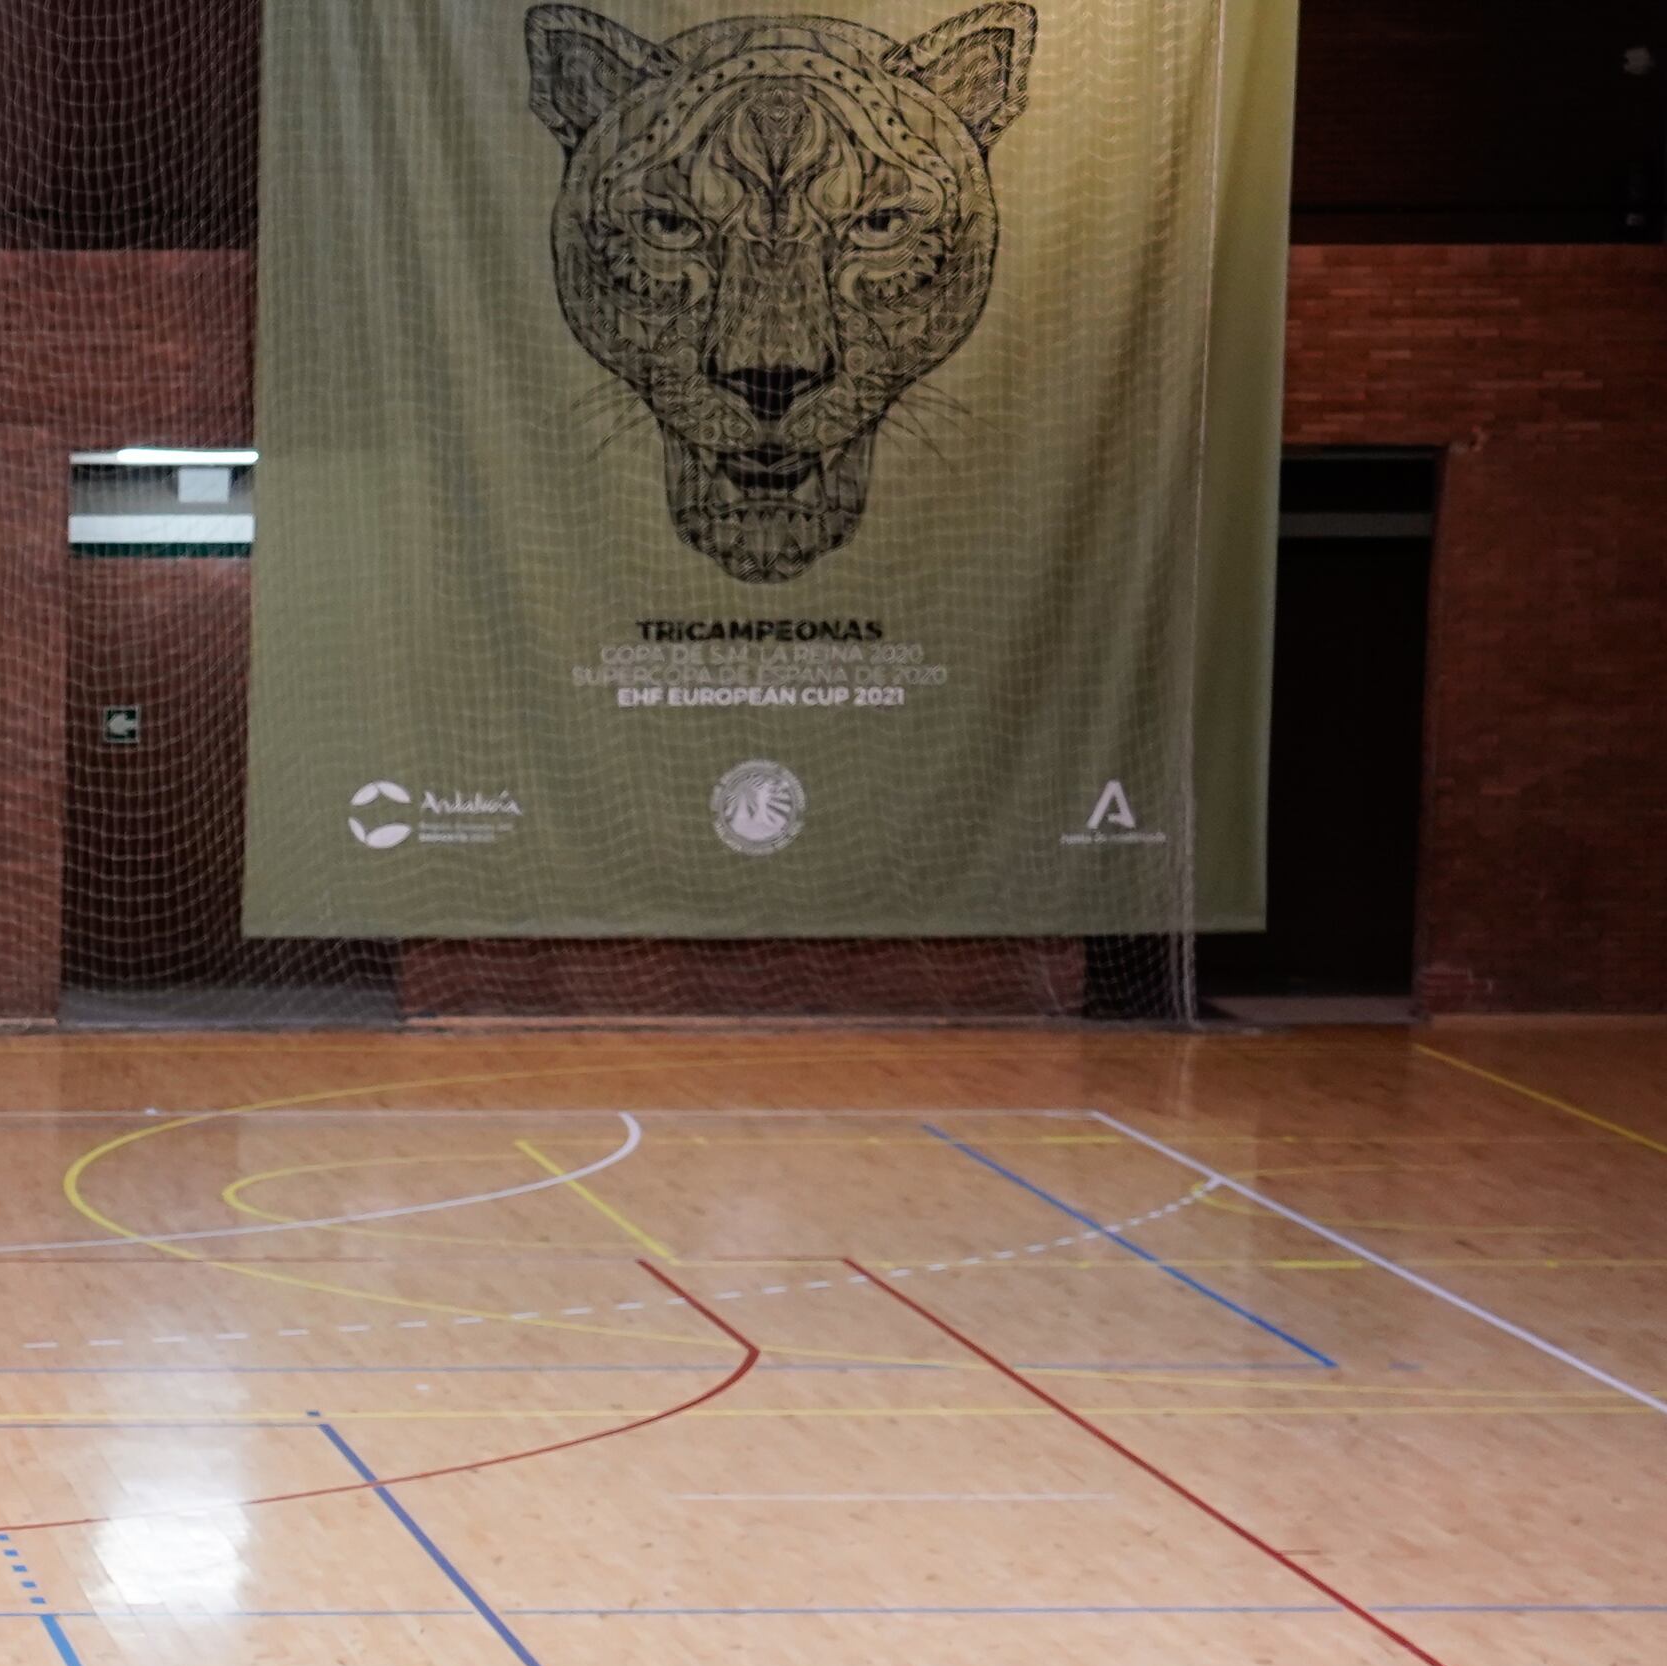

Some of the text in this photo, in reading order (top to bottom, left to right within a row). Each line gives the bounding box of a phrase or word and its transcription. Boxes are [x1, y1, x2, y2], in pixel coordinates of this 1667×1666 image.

[636, 619, 884, 642] TRICAMPEONAS
[601, 645, 665, 664] COPA
[671, 645, 704, 664] DE
[794, 644, 864, 664] REINA
[870, 643, 924, 663] 2020
[572, 666, 713, 687] SUPERCOPA
[717, 666, 750, 686] DE
[855, 665, 884, 685] DE
[892, 664, 948, 685] 2020
[617, 686, 906, 707] EHF EUROPEAN CUP 2021
